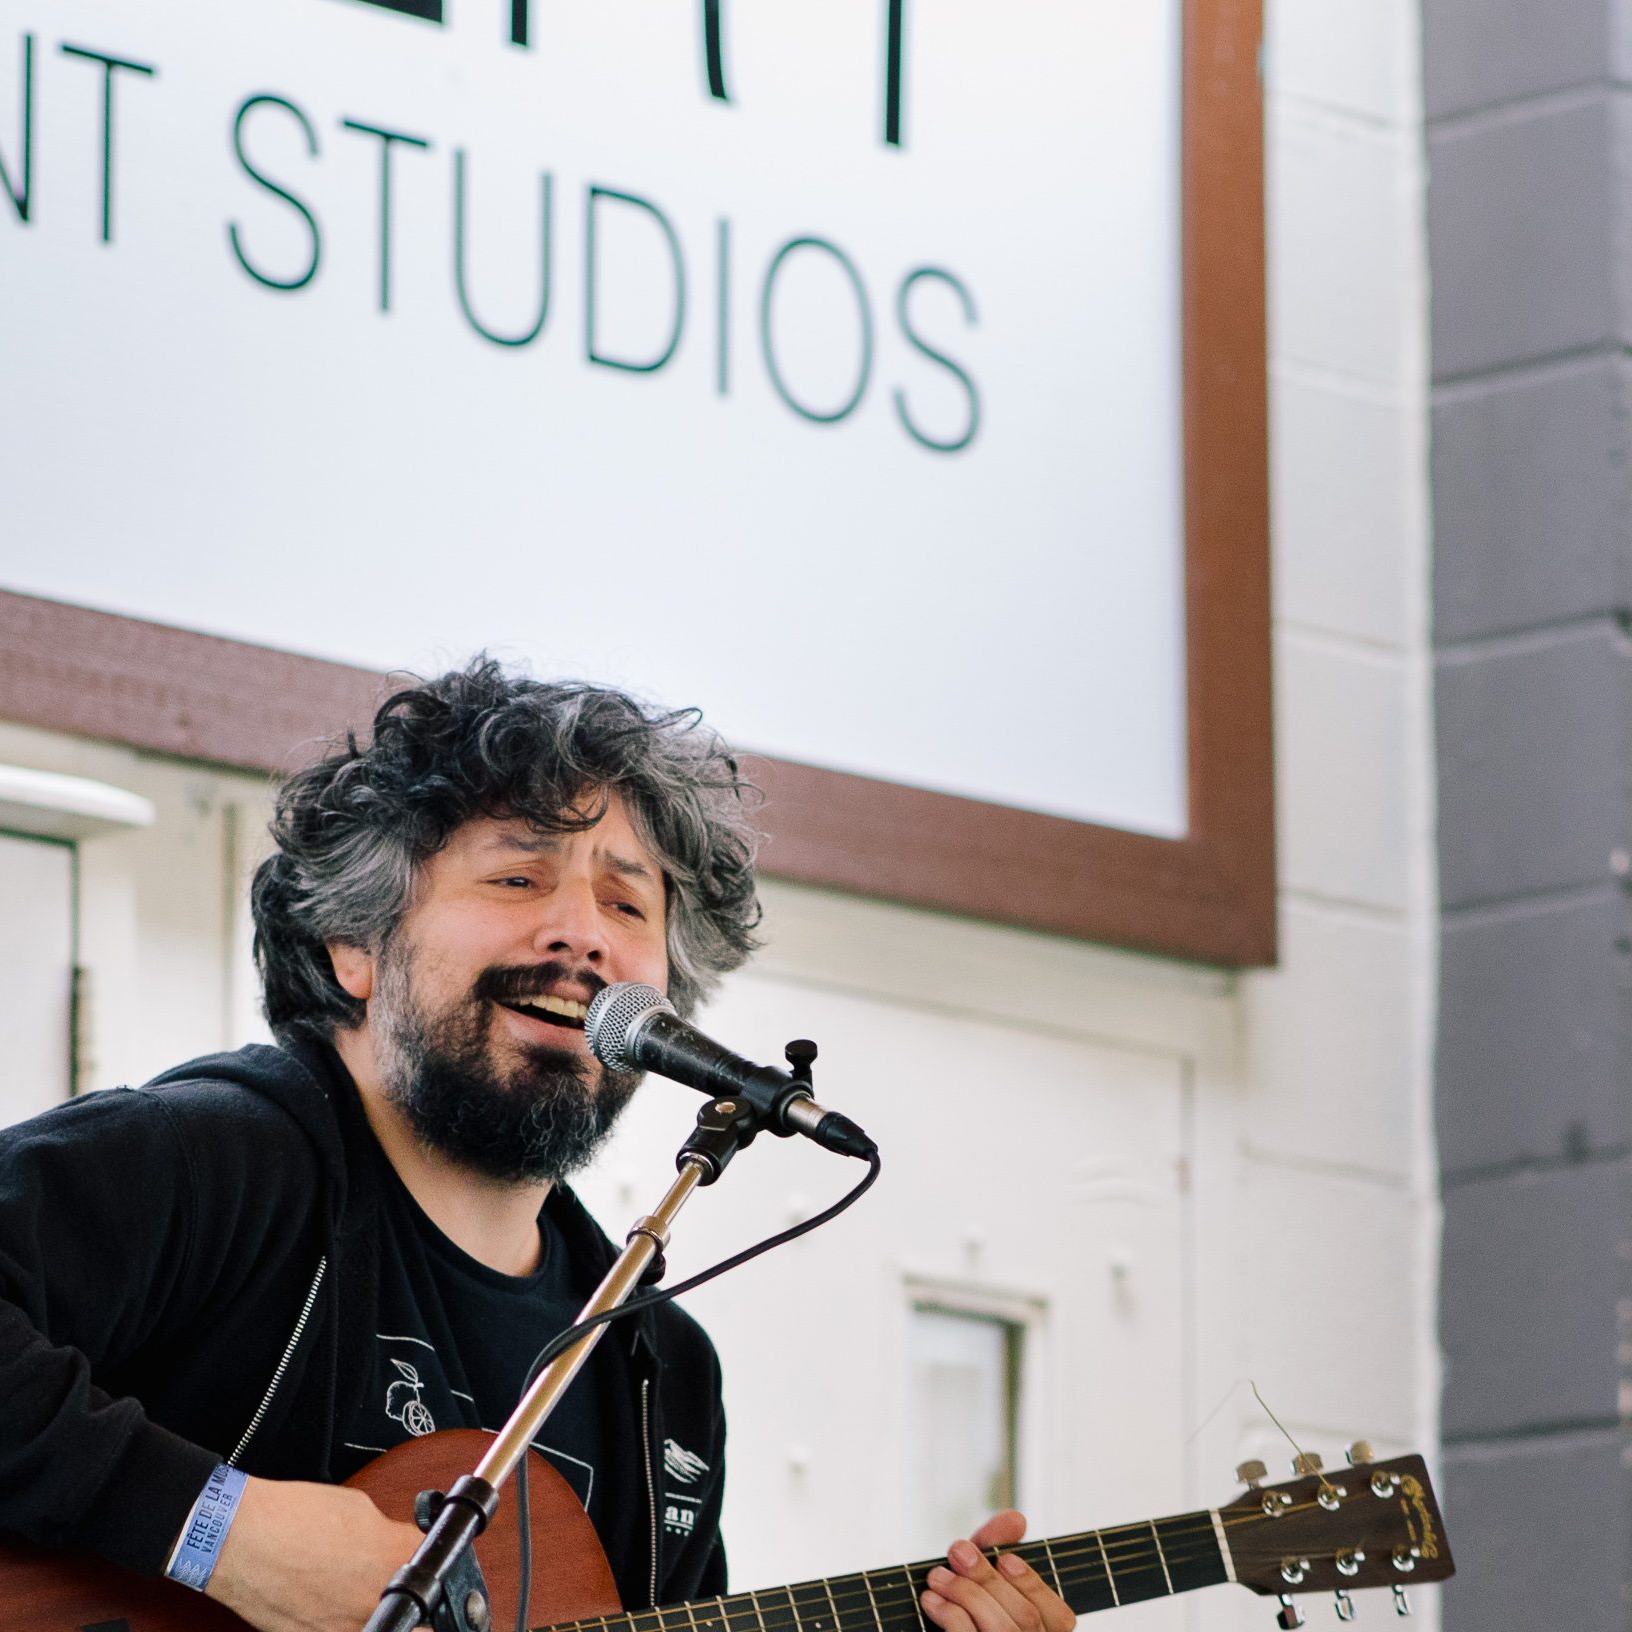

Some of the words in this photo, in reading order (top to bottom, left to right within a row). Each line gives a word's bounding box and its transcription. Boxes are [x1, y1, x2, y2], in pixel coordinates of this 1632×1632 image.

[229, 94, 980, 454] STUDIOS
[205, 1486, 222, 1501] LA
[199, 1502, 216, 1520] DE
[201, 1495, 233, 1553] VANCOUVER
[187, 1520, 209, 1549] FÊTE
